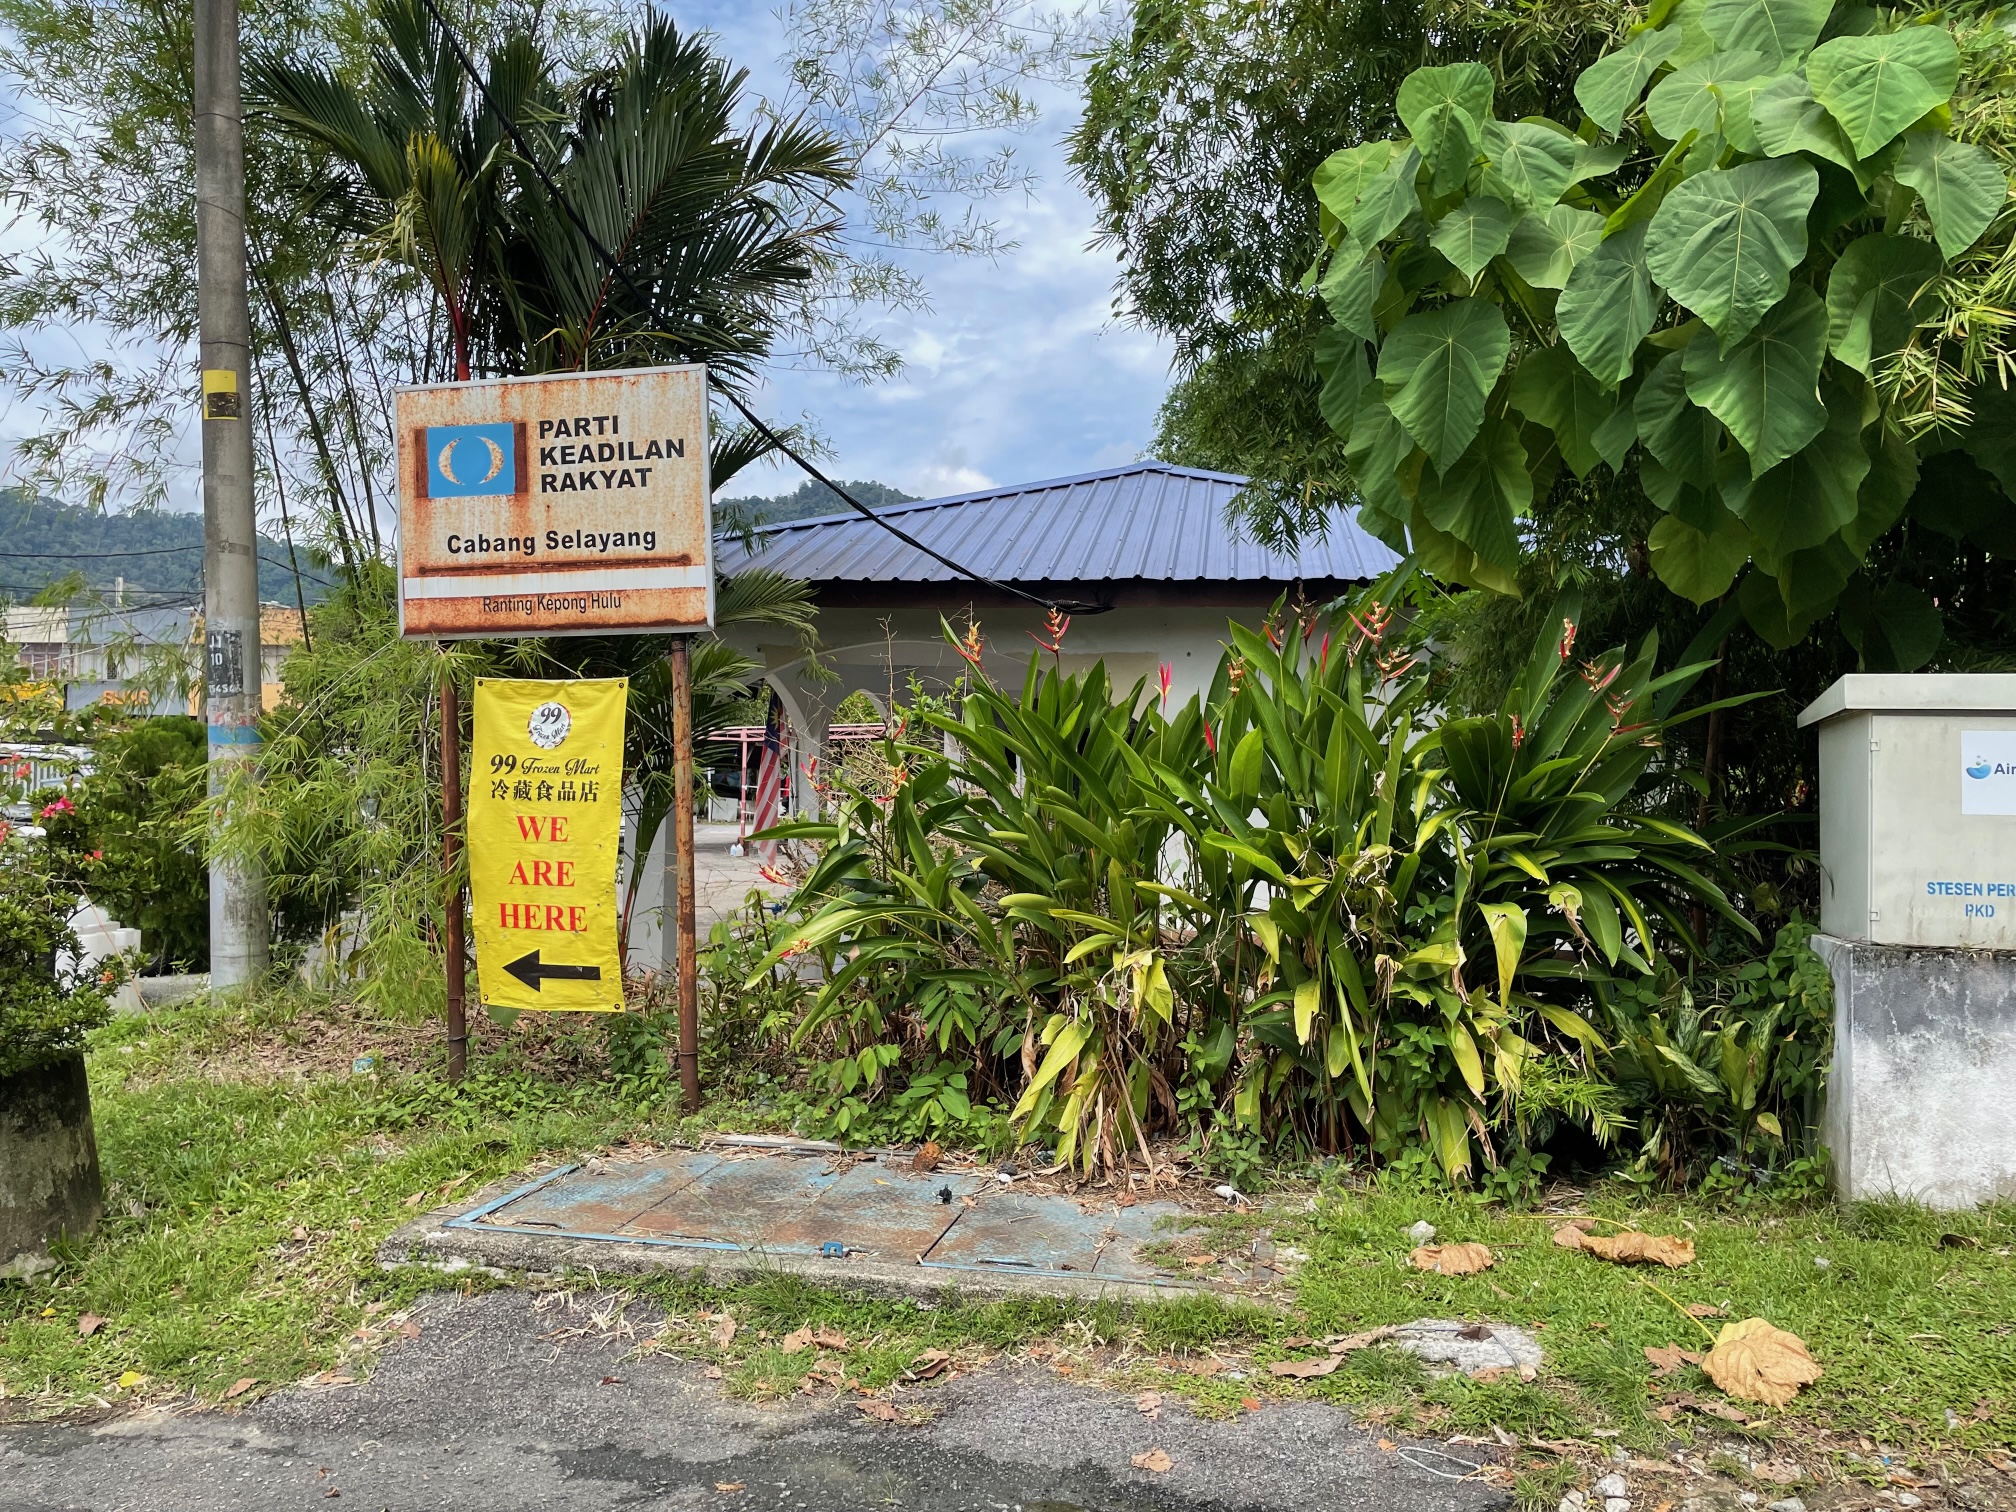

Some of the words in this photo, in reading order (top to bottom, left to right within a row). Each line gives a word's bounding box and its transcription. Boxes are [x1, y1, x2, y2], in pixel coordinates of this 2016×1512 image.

[539, 415, 619, 439] PARTI
[540, 438, 685, 466] KEADILAN
[541, 467, 652, 493] RAKYAT
[447, 533, 535, 555] Cabang
[546, 529, 656, 553] Selayang
[483, 596, 532, 615] Ranting
[537, 594, 587, 614] Kepong
[591, 592, 621, 609] Hulu
[211, 653, 223, 666] 10
[540, 707, 562, 724] 99
[490, 754, 517, 775] 99
[521, 757, 560, 775] Frozen
[564, 758, 600, 776] Mart
[1994, 763, 2016, 775] Air
[491, 779, 600, 803] 冷藏食品店
[516, 815, 569, 842] WE
[508, 860, 575, 887] ARE
[1927, 881, 1983, 896] STESEN
[1987, 883, 2016, 897] PER
[498, 902, 588, 932] HERE
[1965, 903, 1995, 918] PKD
